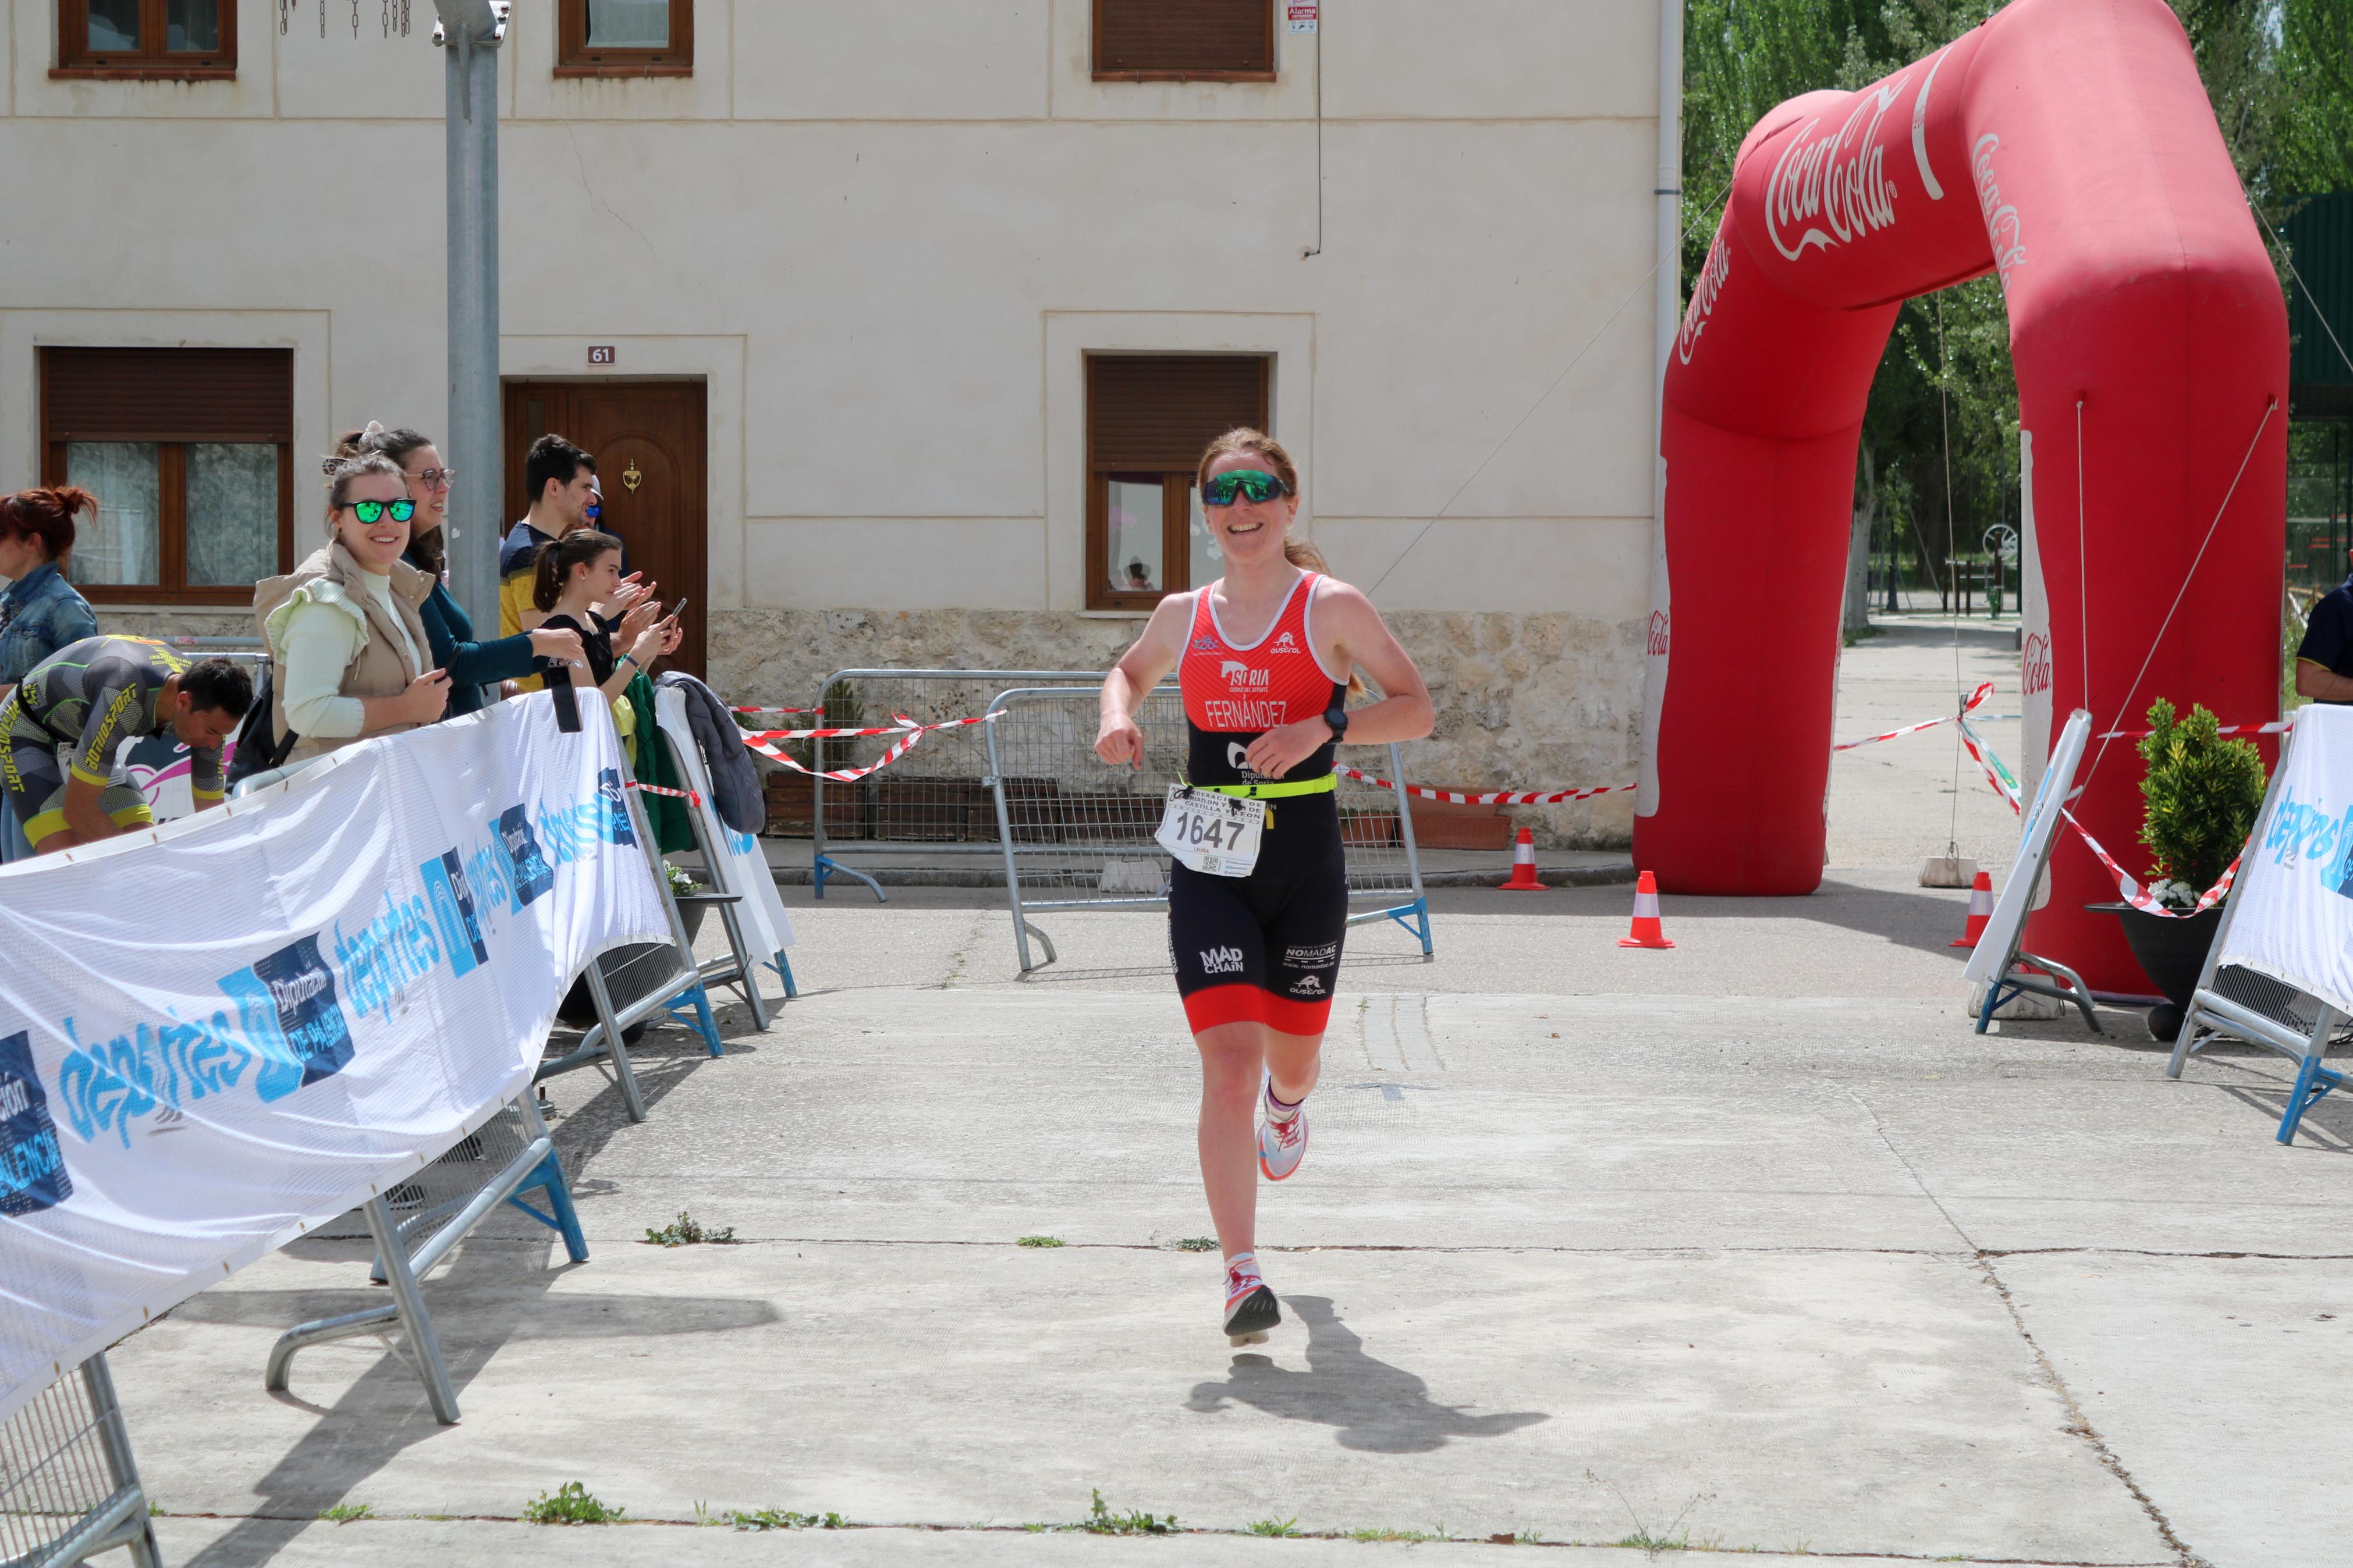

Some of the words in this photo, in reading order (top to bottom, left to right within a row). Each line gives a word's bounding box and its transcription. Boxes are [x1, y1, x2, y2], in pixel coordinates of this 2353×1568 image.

[592, 349, 609, 362] 61
[1205, 694, 1289, 728] FERNÁNDEZ
[85, 682, 136, 771] BOTUOSPORT
[1185, 801, 1220, 812] CASTILLA
[1234, 810, 1260, 819] LEON
[1177, 812, 1245, 851] 1647
[1199, 945, 1243, 966] MAD
[1286, 945, 1336, 957] NOMADAC
[1301, 961, 1335, 969] nomadac.es
